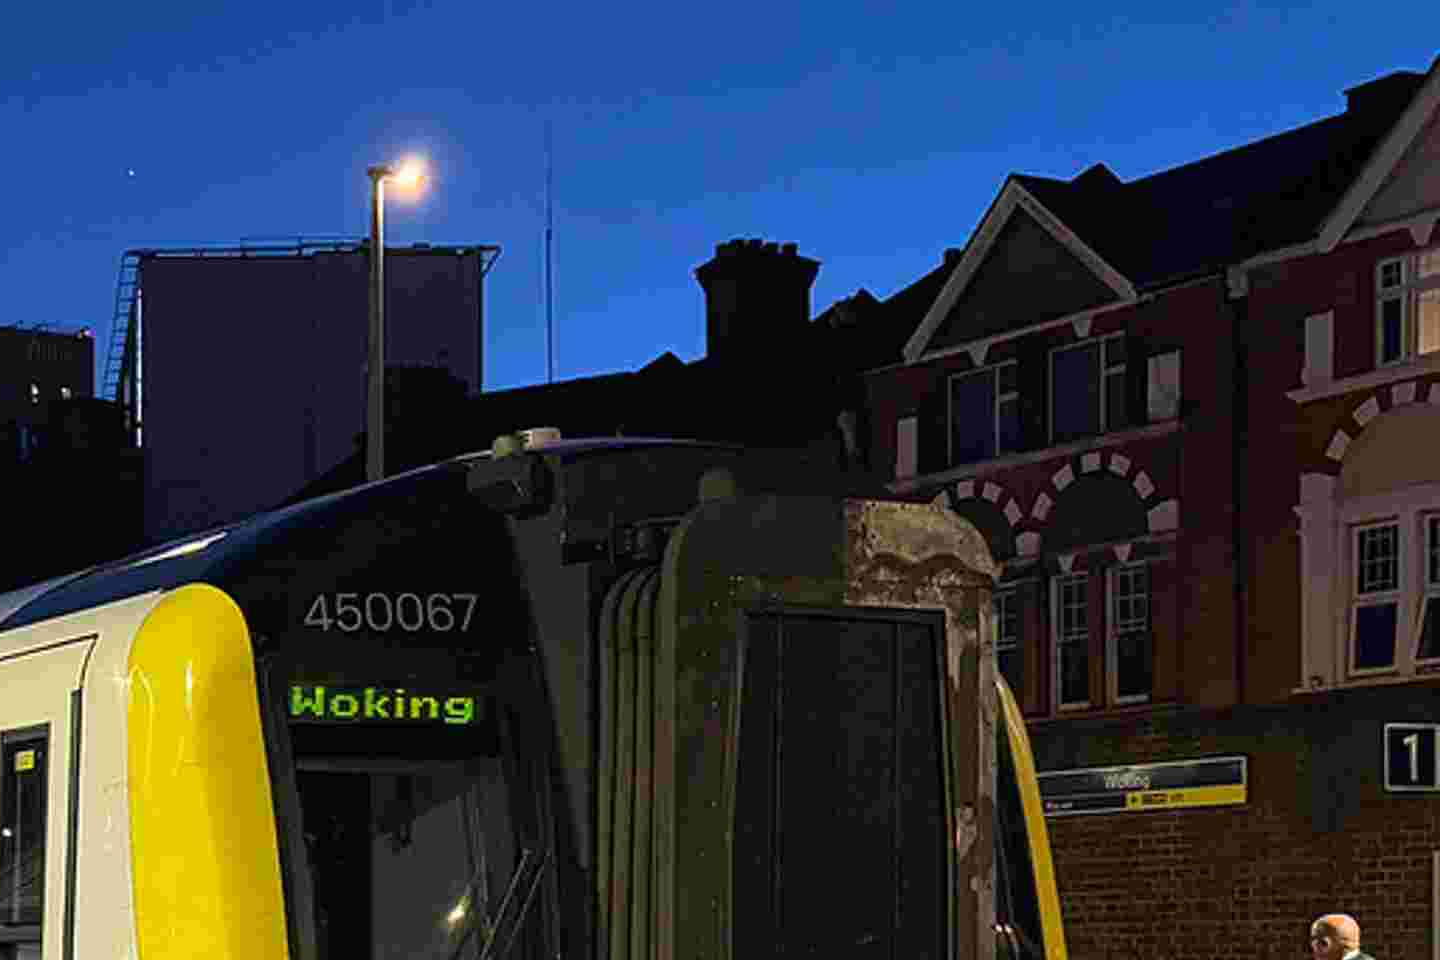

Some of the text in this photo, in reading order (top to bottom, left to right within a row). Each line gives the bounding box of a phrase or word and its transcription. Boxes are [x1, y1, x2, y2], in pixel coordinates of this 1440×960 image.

[303, 591, 481, 632] 450067
[289, 685, 475, 725] Woking
[1402, 732, 1420, 783] 1
